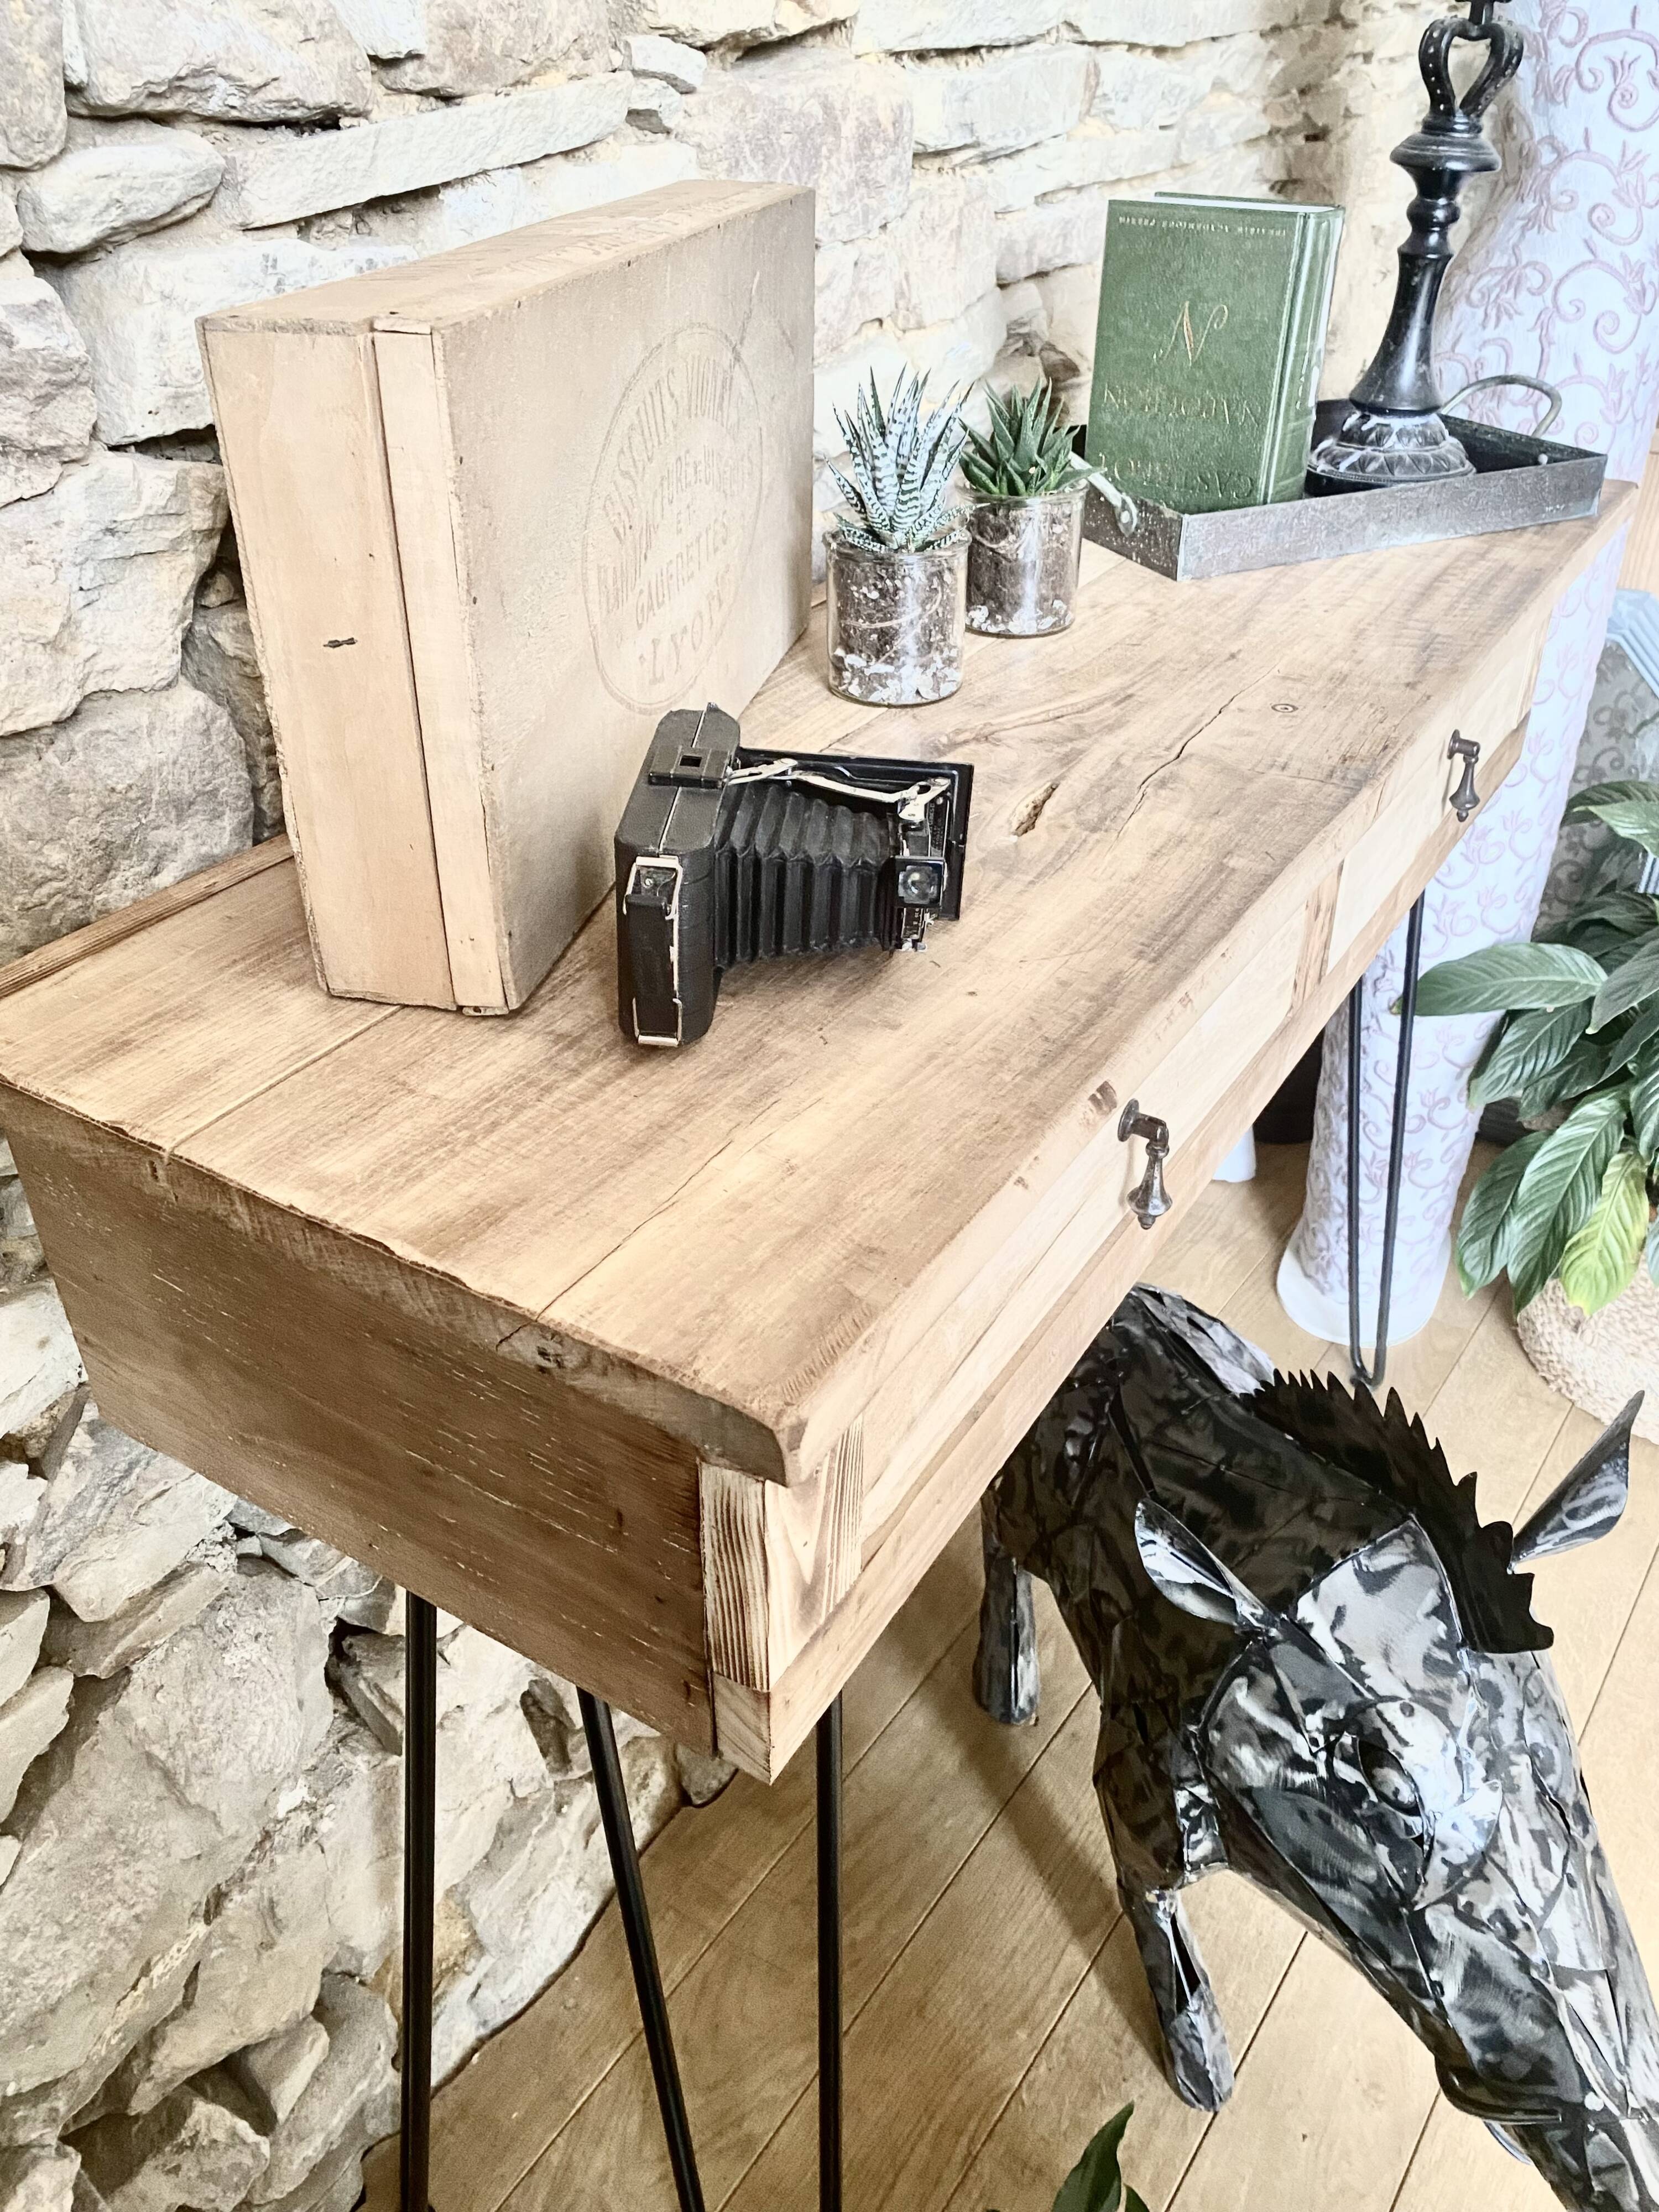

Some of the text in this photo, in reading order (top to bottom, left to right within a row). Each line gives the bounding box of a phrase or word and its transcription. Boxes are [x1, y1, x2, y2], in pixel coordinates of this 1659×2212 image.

[1152, 301, 1229, 367] N
[606, 366, 680, 541] BISCUITS
[597, 448, 691, 616] MANUFACTURE
[637, 508, 728, 631] GAUFRETTES
[676, 504, 696, 536] ET
